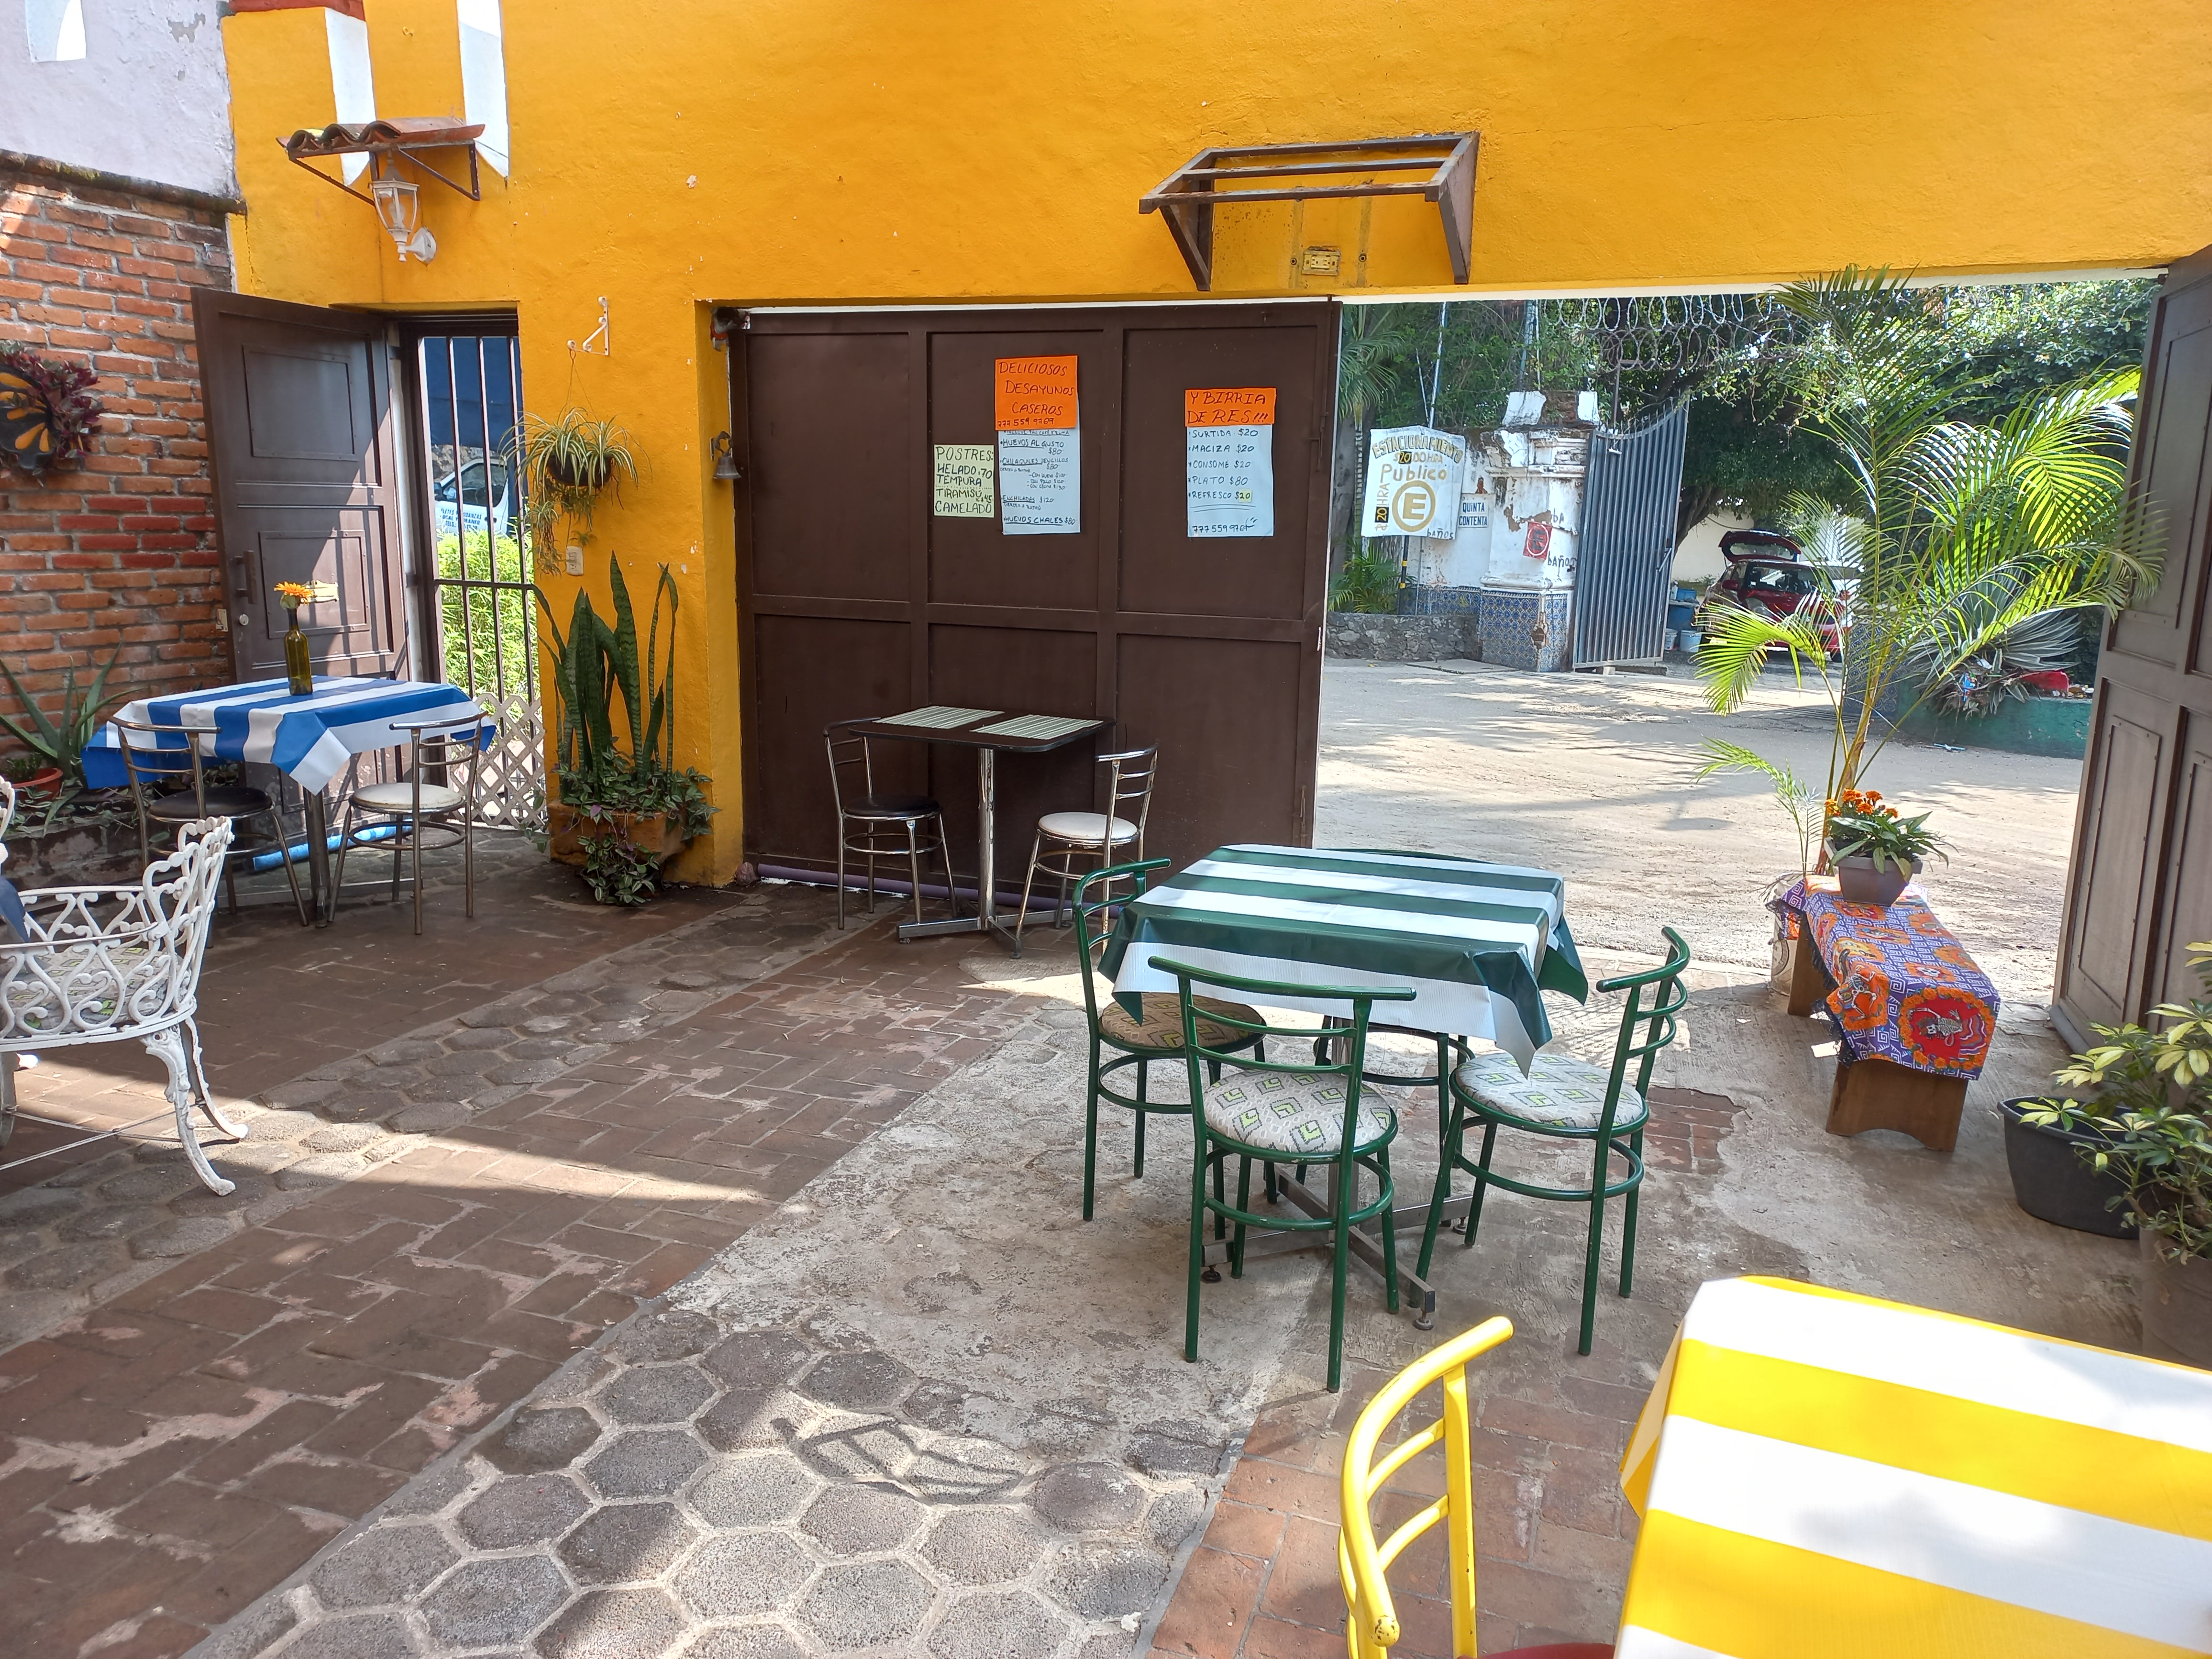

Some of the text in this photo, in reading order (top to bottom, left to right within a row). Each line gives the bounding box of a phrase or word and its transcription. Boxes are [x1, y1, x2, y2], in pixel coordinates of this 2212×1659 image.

[999, 361, 1068, 376] DELICIOSOS
[1005, 380, 1075, 396] DESAYUNOS
[1190, 391, 1266, 405] Y BIRRIA
[1012, 401, 1063, 416] CASEROS
[1186, 410, 1208, 423] DE
[1192, 428, 1258, 438] SURTIDA $20
[1003, 438, 1029, 447] HUEVOS
[1192, 444, 1254, 453] MACIZA $20
[1048, 447, 1062, 455] $80
[1371, 434, 1464, 464] ESTACIONAMIENTO
[937, 463, 976, 475] HELADO
[1233, 460, 1251, 469] $20
[1192, 475, 1248, 487] PLATO $80
[935, 488, 983, 499] TIRAMISÚ
[1192, 491, 1250, 500] REFRESCO $20
[935, 500, 992, 514] CAMELADO
[1402, 492, 1427, 520] E
[1459, 515, 1487, 526] CONTENTA
[1192, 525, 1210, 533] 777
[1212, 524, 1228, 532] 559
